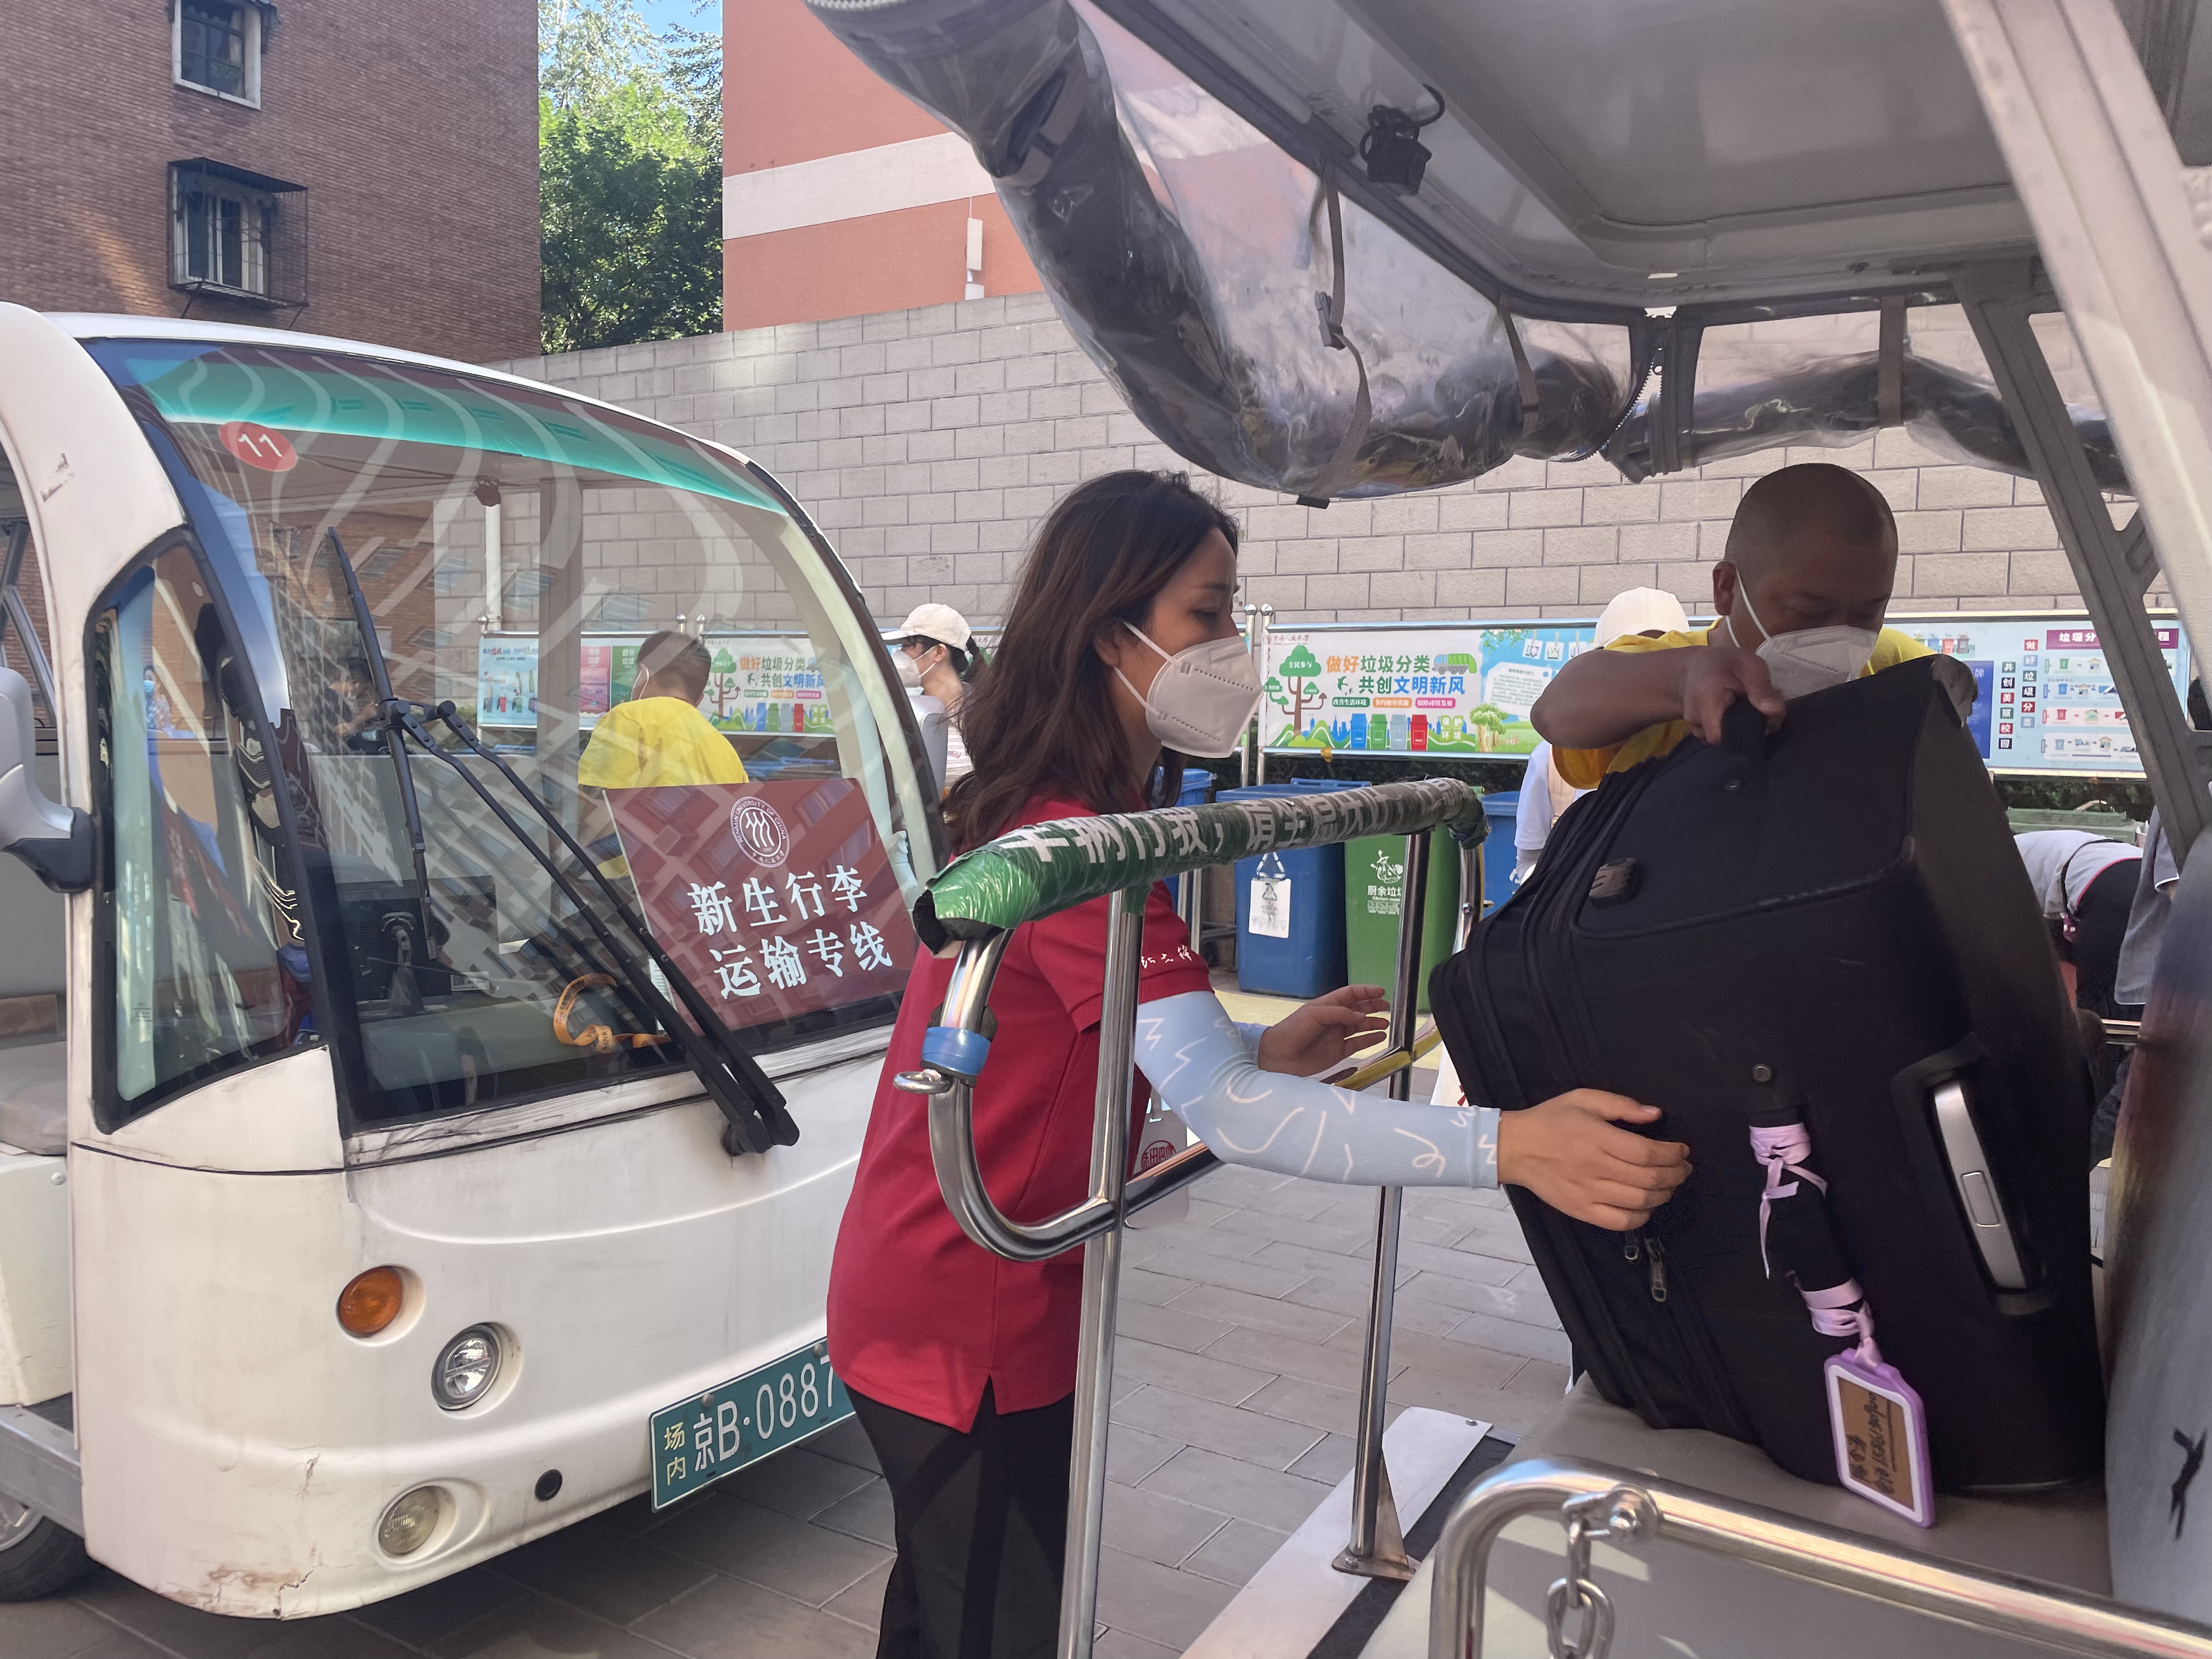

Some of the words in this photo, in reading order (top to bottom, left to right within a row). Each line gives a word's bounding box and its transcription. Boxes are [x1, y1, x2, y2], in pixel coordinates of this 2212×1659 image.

[238, 433, 283, 458] 11
[1326, 654, 1430, 674] 做好垃圾分类
[1358, 676, 1466, 695] 共创文明新风
[735, 800, 765, 815] UNIVERSITY
[766, 808, 775, 816] OF
[774, 817, 787, 840] CHINA
[687, 865, 868, 936] 新生行李
[709, 921, 893, 1000] 运输专线
